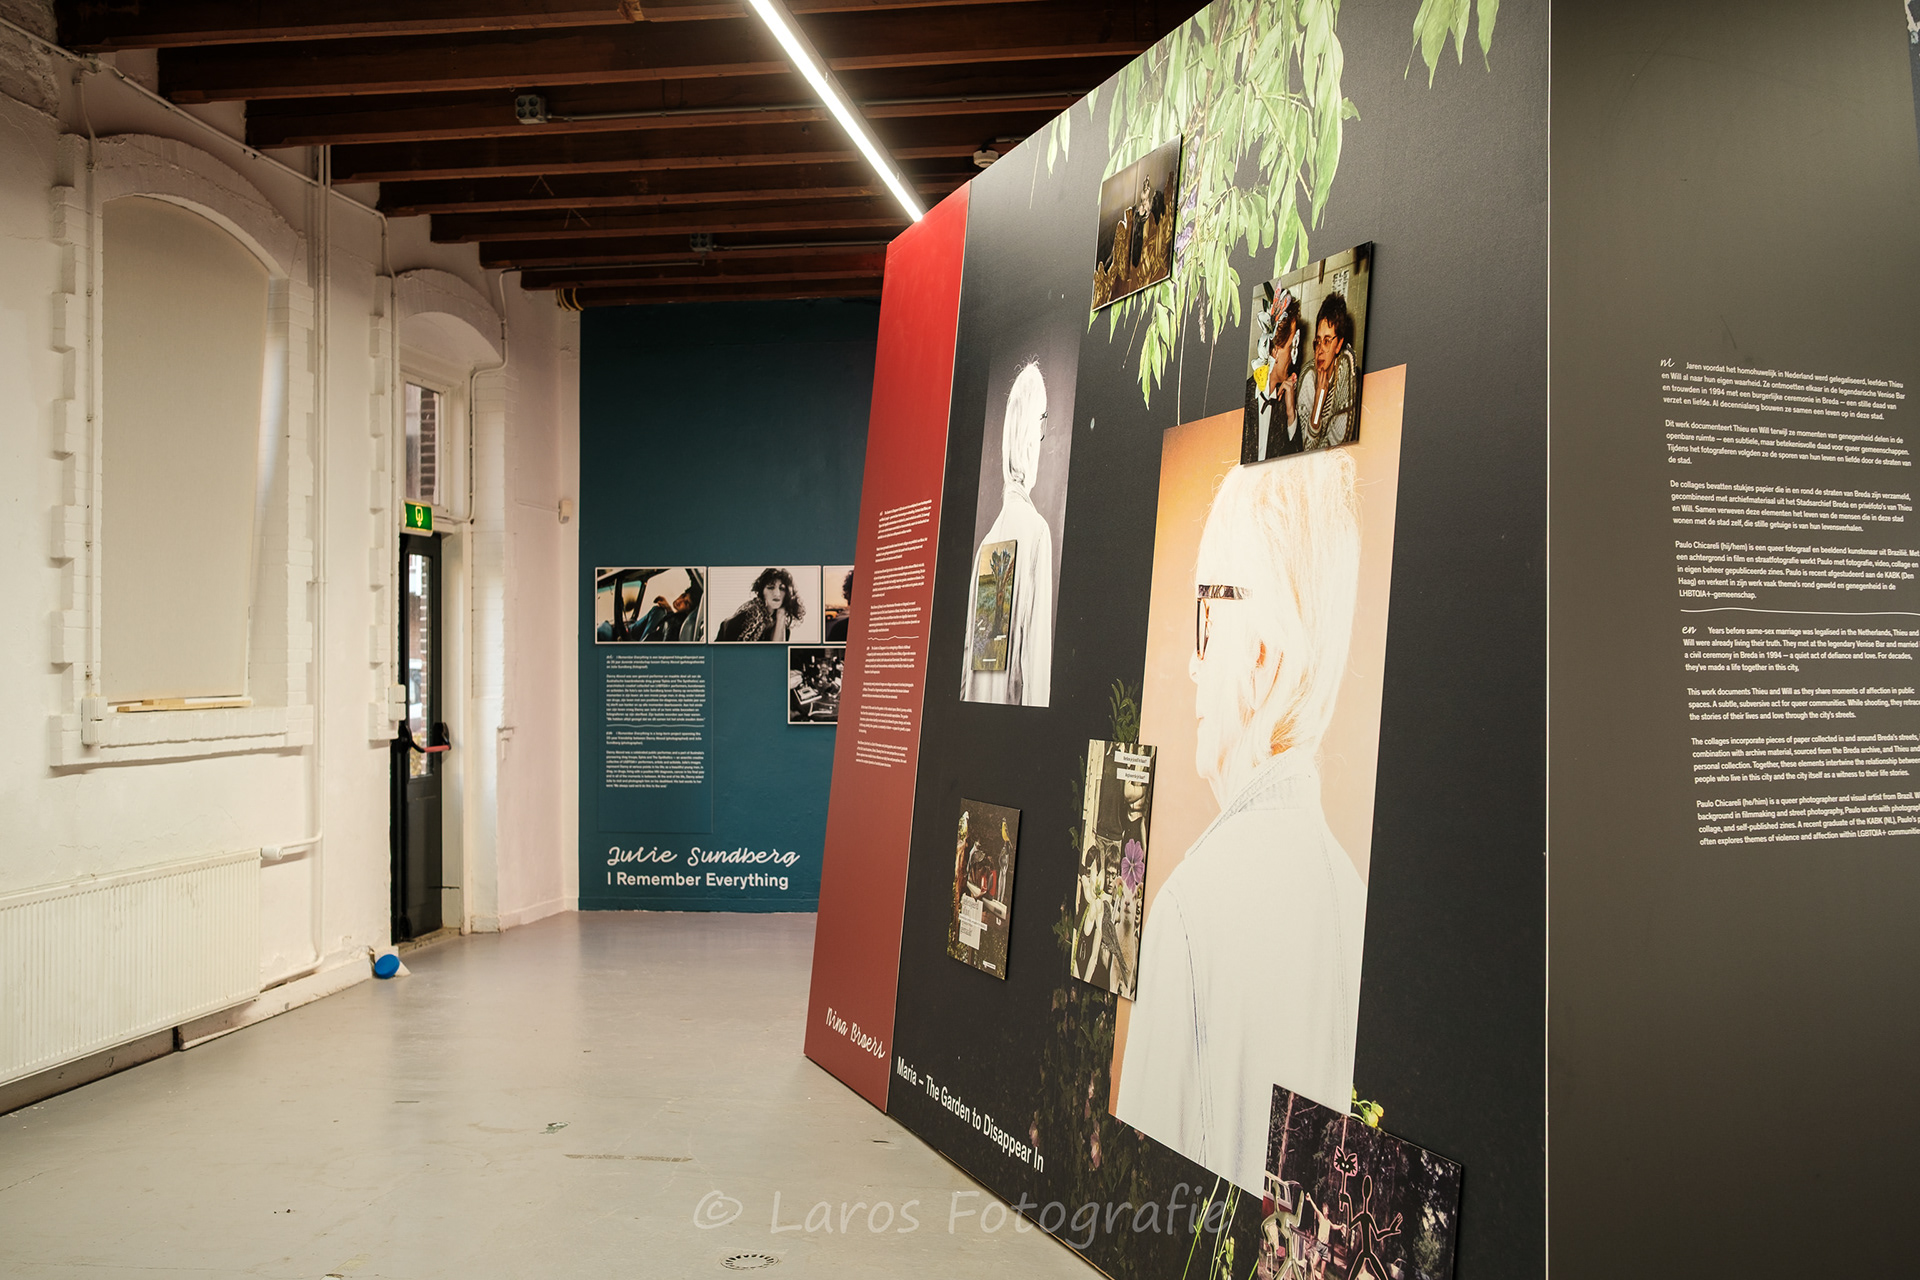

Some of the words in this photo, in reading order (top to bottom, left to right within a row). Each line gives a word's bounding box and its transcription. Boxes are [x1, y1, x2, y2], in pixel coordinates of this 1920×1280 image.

[1686, 362, 1702, 370] Jaren
[1736, 366, 1777, 378] homohuwelijk
[1784, 371, 1814, 380] Nederland
[1716, 376, 1734, 386] eigen
[1771, 382, 1805, 390] ontmoetten
[1720, 400, 1760, 412] decennialang
[1760, 403, 1784, 412] bouwen
[1665, 419, 1675, 427] Dit
[1690, 422, 1733, 431] documenteert
[1733, 424, 1750, 432] Thieu
[1770, 427, 1788, 437] terwijl
[1769, 521, 1792, 530] getuige
[1682, 626, 1697, 634] en
[1775, 627, 1802, 636] marriage
[1685, 663, 1707, 672] they've
[1741, 664, 1767, 672] together
[1785, 711, 1808, 720] through
[1694, 775, 1716, 784] people
[1761, 773, 1772, 782] city
[1796, 772, 1808, 781] city
[607, 846, 678, 866] Julie
[687, 847, 800, 868] Sundberg
[607, 872, 611, 885] I
[617, 872, 701, 886] Remember
[706, 873, 789, 890] Everything
[850, 1022, 885, 1059] Broers
[897, 1056, 917, 1087] Maria
[925, 1074, 940, 1102] The
[941, 1086, 970, 1124] Garden
[972, 1108, 982, 1131] to
[983, 1114, 1032, 1164] Disappear
[1034, 1146, 1044, 1173] In
